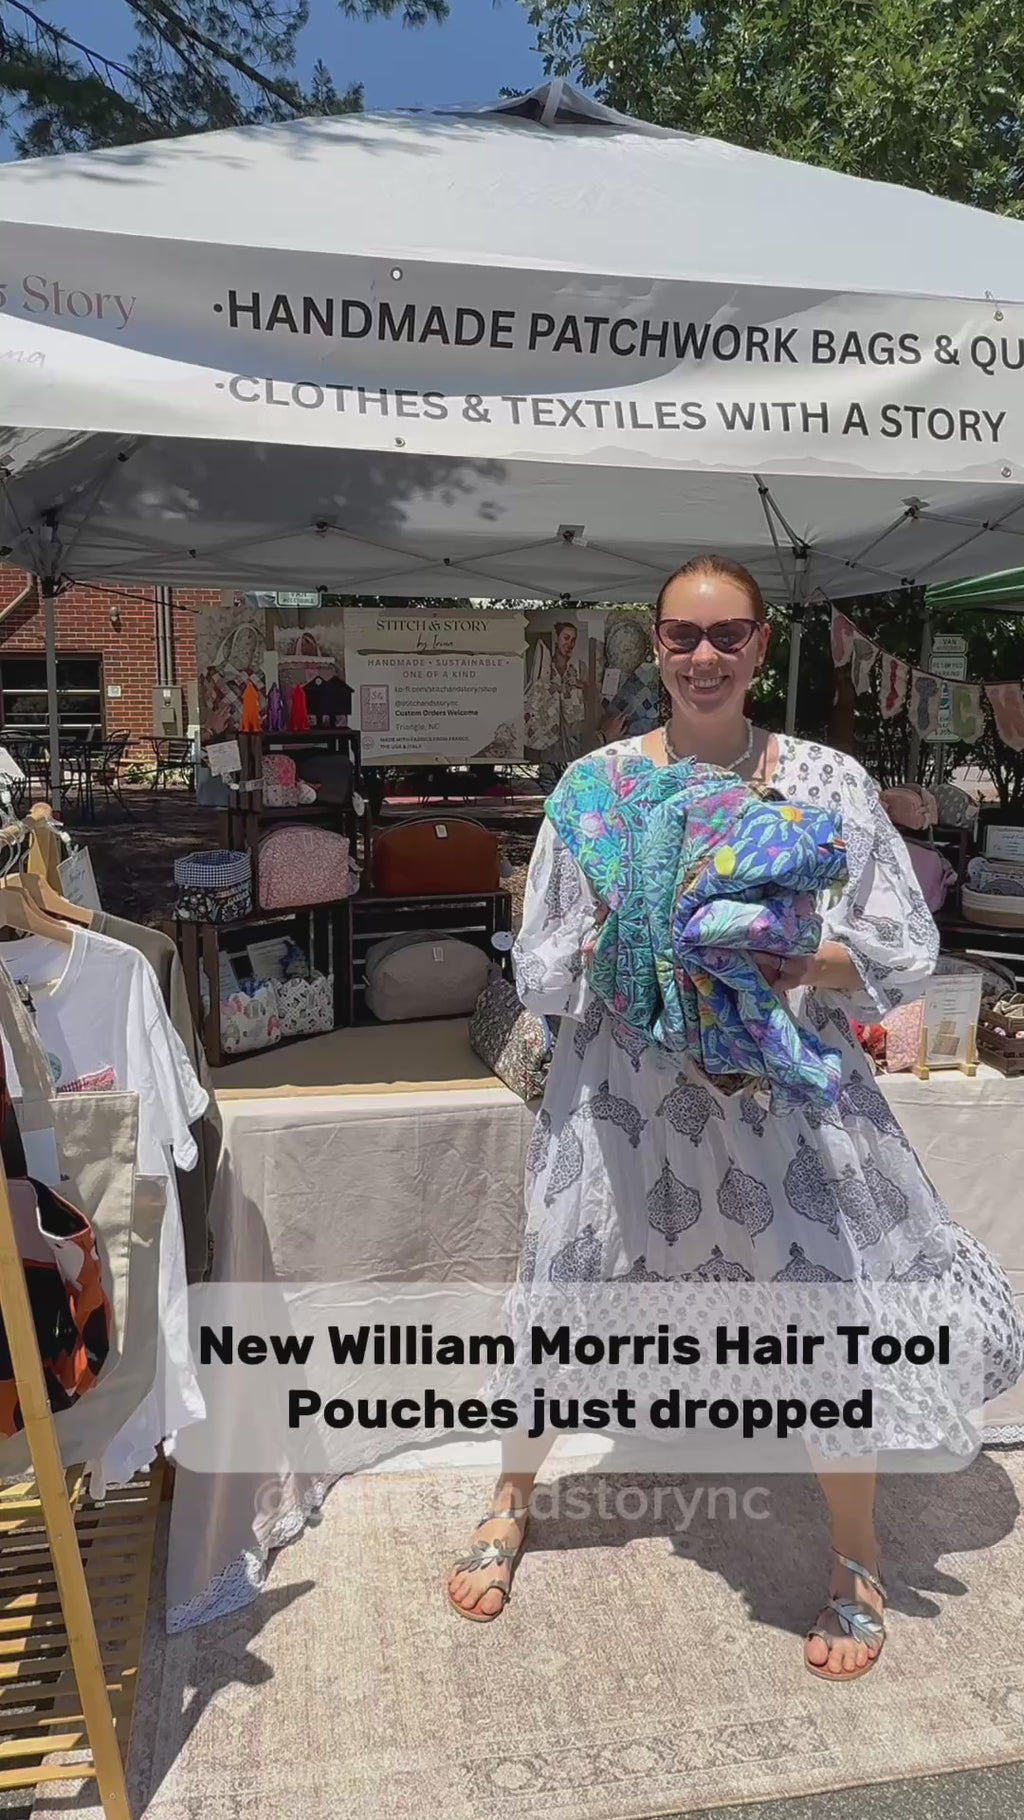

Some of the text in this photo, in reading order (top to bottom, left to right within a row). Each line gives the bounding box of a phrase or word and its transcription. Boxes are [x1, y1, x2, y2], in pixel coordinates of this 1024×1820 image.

[22, 274, 137, 330] Story
[227, 289, 516, 349] HANDMADE
[527, 311, 799, 364] PATCHWORK
[811, 329, 922, 366] BAGS
[932, 334, 960, 366] &
[229, 373, 1008, 443] CLOTHES & TEXTILES WITH A STORY
[376, 619, 427, 632] STITCH
[443, 619, 489, 632] STORY
[416, 633, 428, 650] by
[367, 659, 502, 667] HANDMADE SUSTAINABLE
[402, 670, 423, 679] ONE
[426, 670, 439, 679] OF
[452, 670, 476, 679] KIND
[395, 709, 479, 717] Custom Orders Welcome
